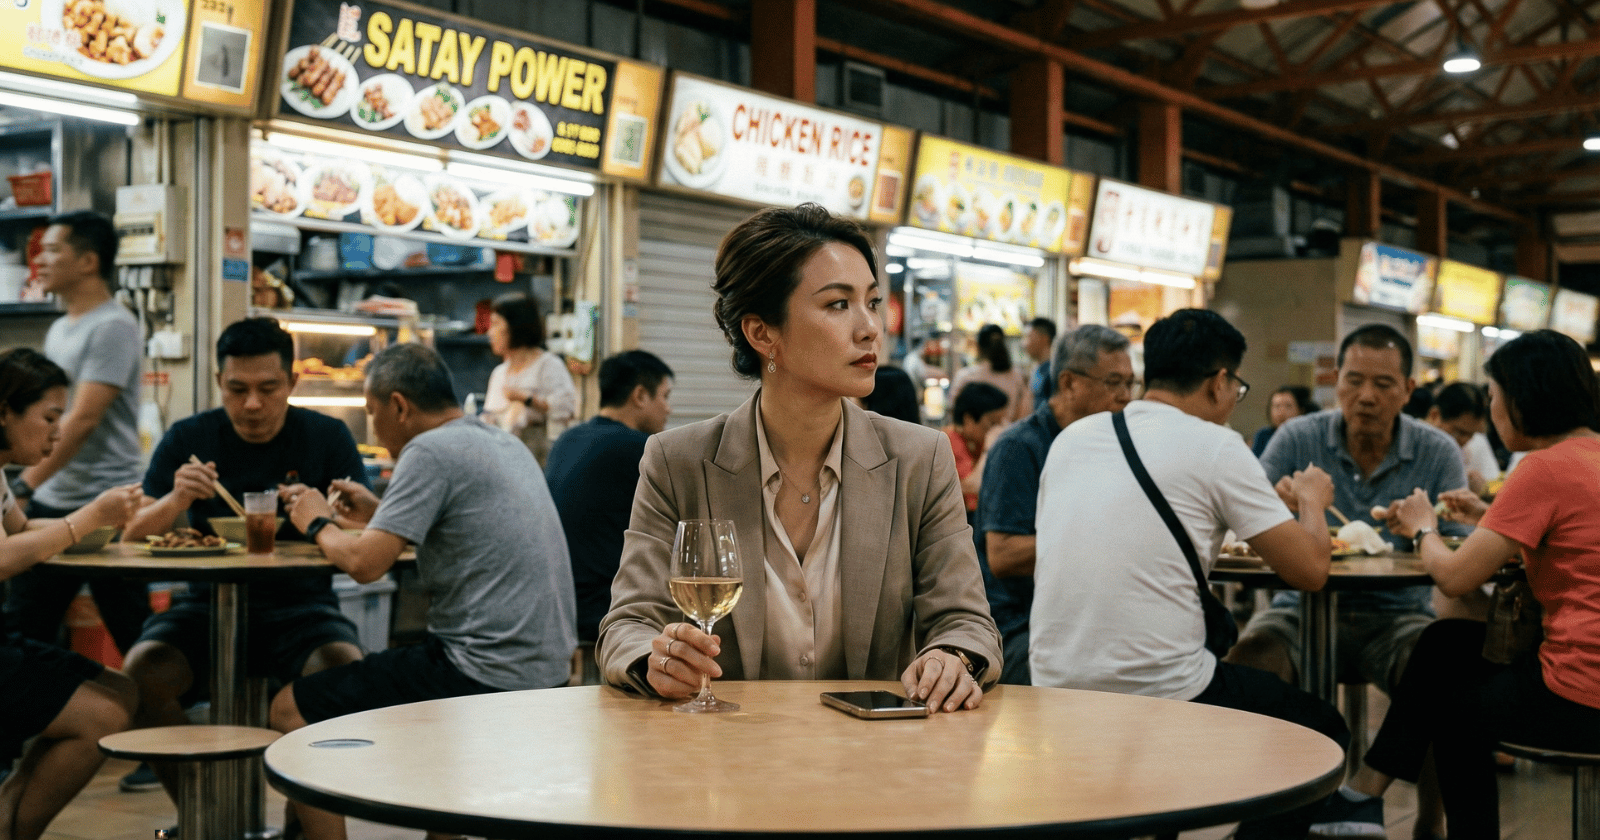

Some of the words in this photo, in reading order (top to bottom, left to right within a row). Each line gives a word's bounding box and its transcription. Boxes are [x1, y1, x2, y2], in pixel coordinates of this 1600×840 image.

[364, 11, 487, 86] SATAY
[487, 40, 608, 115] POWER
[732, 104, 825, 157] CHICKEN
[828, 126, 874, 167] RICE
